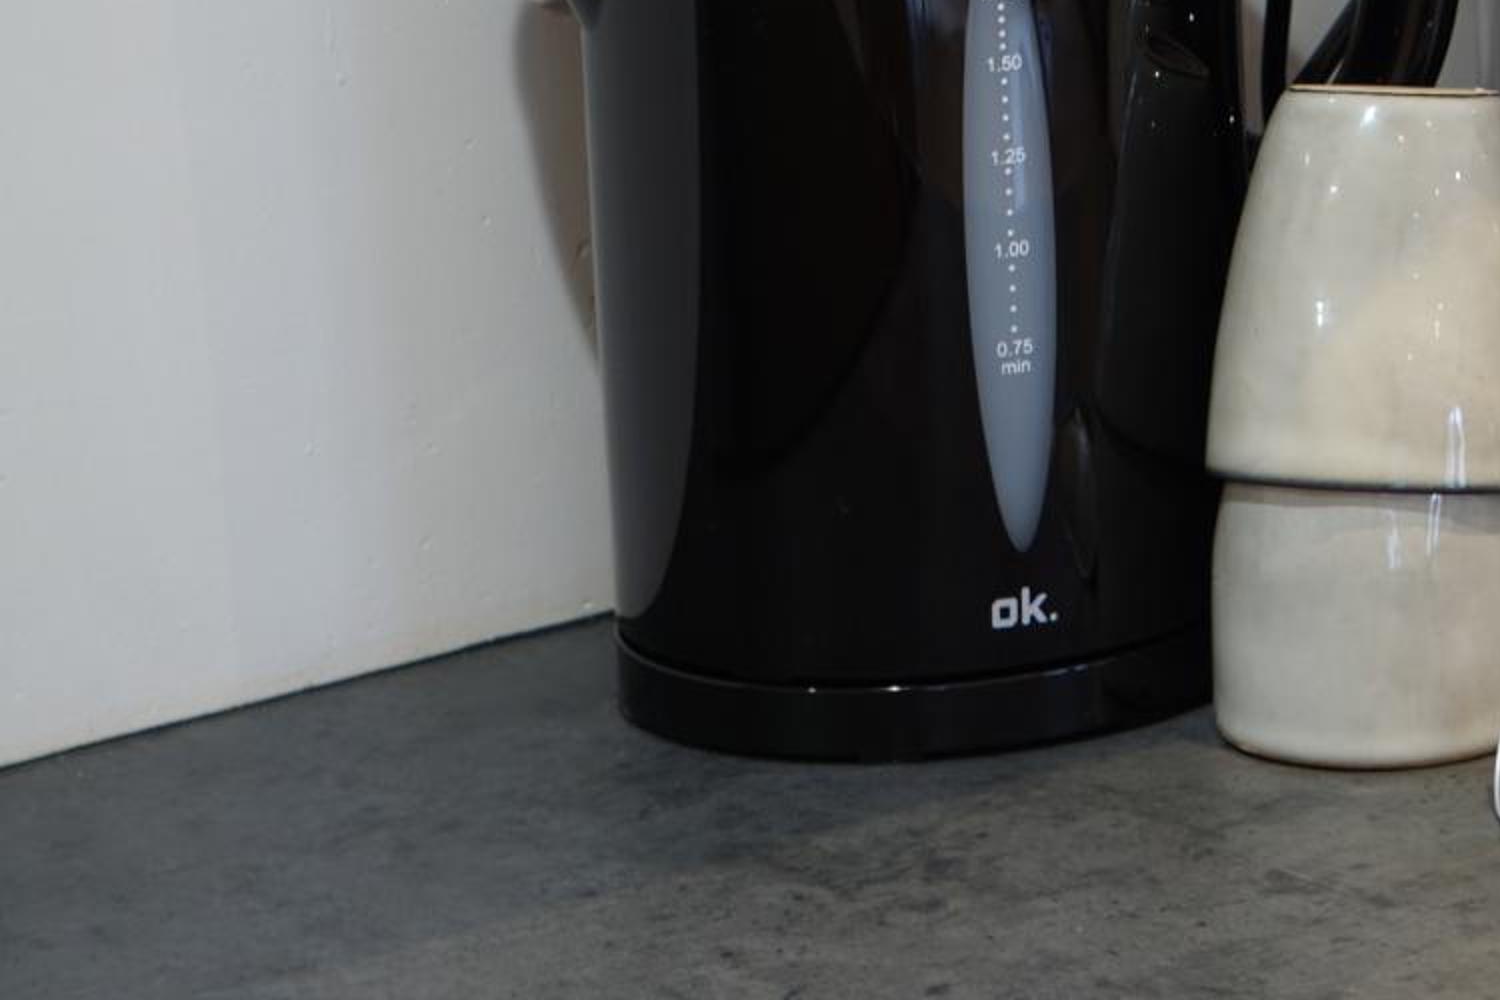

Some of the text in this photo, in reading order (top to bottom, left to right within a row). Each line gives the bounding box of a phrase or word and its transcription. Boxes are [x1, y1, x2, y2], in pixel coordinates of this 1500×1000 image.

[987, 54, 1023, 73] 1.50
[991, 147, 1026, 166] 1.25
[994, 240, 1030, 259] 1.00
[997, 338, 1034, 358] 0.75
[1001, 357, 1032, 376] min
